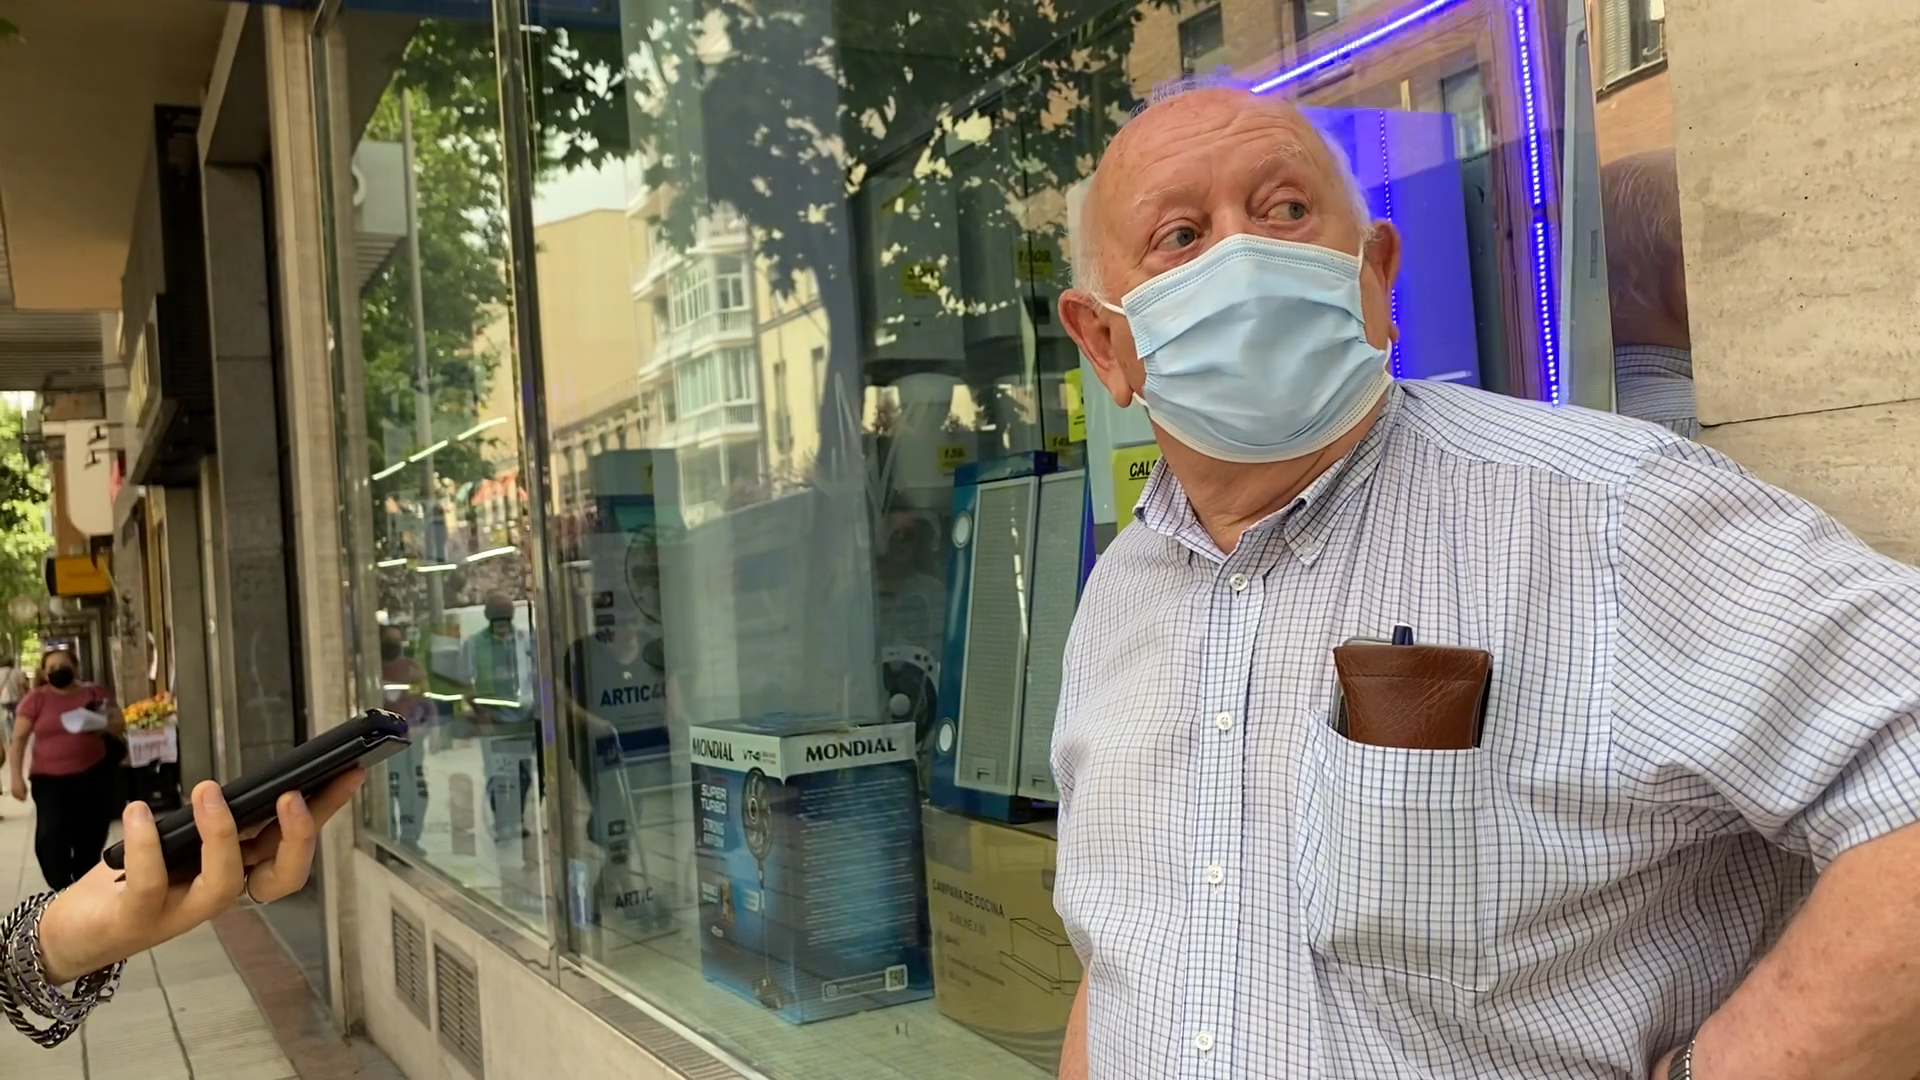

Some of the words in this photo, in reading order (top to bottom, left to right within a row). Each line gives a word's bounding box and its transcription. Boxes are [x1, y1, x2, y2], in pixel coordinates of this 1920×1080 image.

[692, 737, 735, 762] MONDIAL
[806, 736, 897, 763] MONDIAL
[701, 783, 727, 801] SUPER
[700, 797, 727, 815] TURBO
[963, 890, 974, 907] DE
